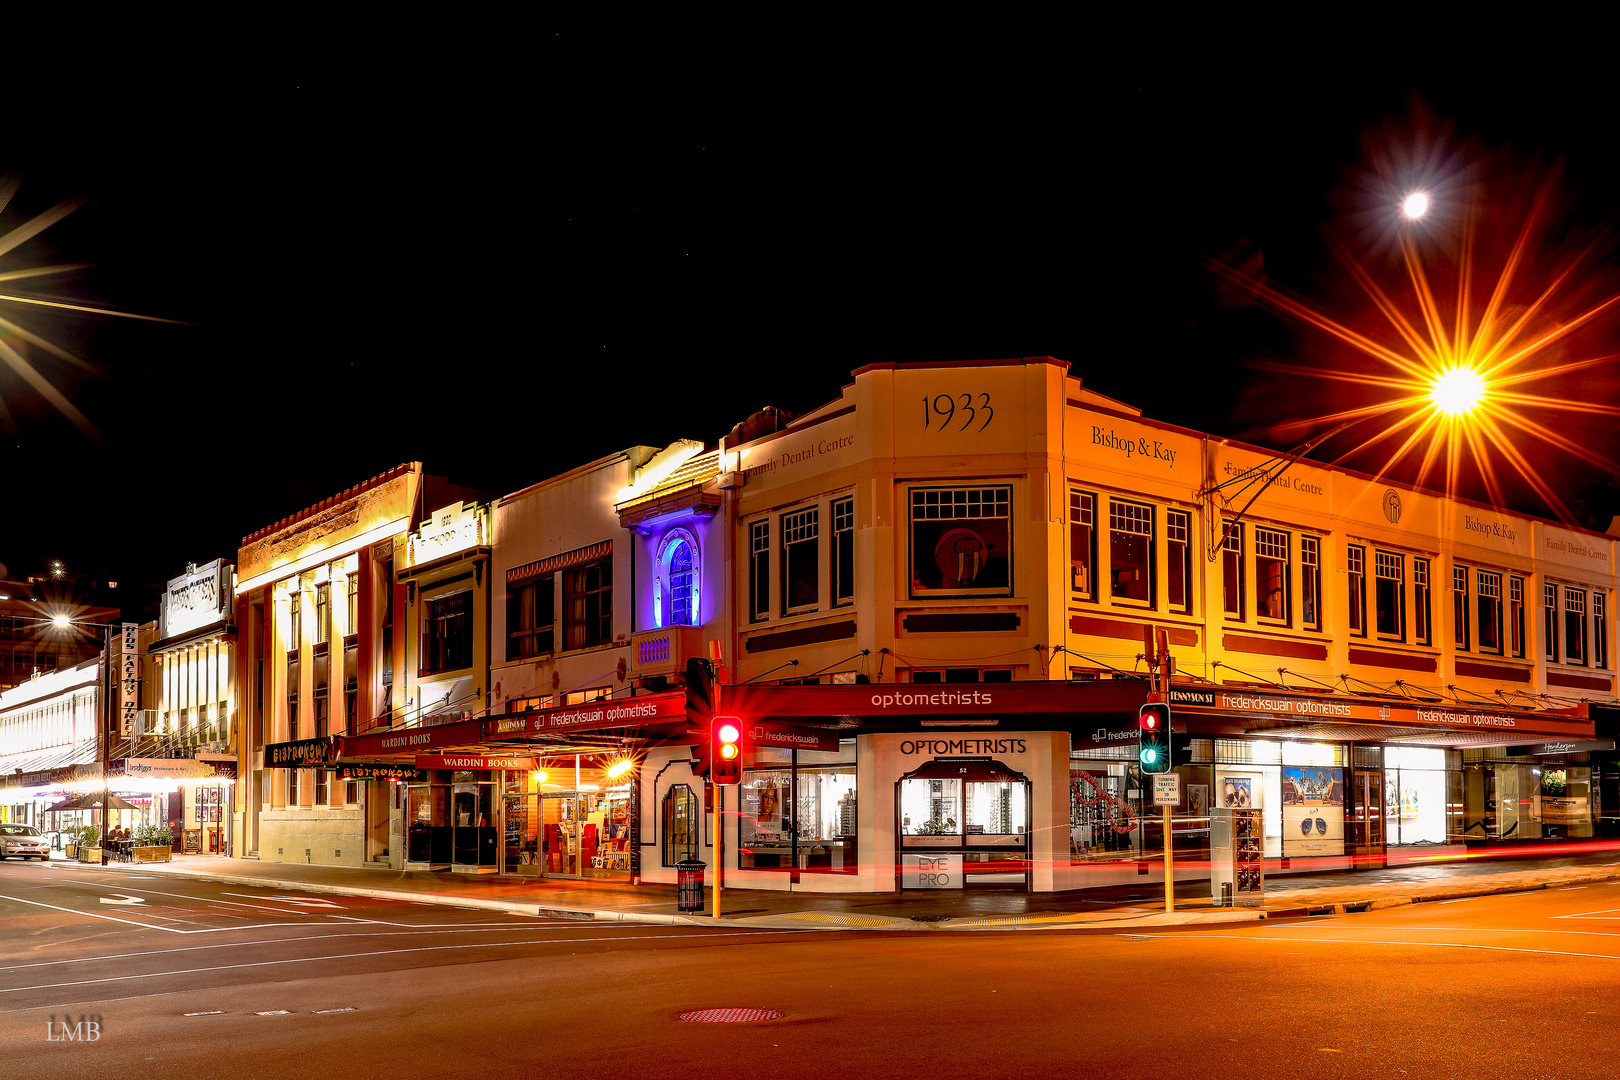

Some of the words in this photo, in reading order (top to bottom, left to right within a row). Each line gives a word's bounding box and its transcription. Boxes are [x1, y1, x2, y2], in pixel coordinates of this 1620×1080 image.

[923, 393, 993, 433] 1933
[1091, 425, 1135, 458] Bishop
[1138, 437, 1151, 457] &
[1153, 441, 1177, 468] Kay
[747, 457, 778, 478] Family
[781, 444, 815, 467] Dental
[817, 435, 854, 455] Centre
[1226, 461, 1257, 484] Family
[1293, 478, 1323, 496] Centre
[1464, 515, 1492, 538] Bishop
[1492, 522, 1501, 536] &
[1501, 524, 1517, 544] Kay
[1546, 538, 1567, 555] Family
[1568, 542, 1587, 557] Dental
[1589, 547, 1608, 561] Centre
[871, 690, 992, 708] optometrists
[1170, 691, 1204, 702] TENNYSON
[1205, 694, 1214, 703] ST
[1221, 693, 1293, 712] frederickswain
[1296, 699, 1351, 716] optometrists
[550, 709, 604, 727] frederickswain
[606, 703, 657, 721] optometrists
[1417, 708, 1470, 724] frederickswain
[1472, 714, 1516, 726] optometrists
[382, 737, 408, 748] WARDINI
[410, 734, 431, 745] BOOKS
[765, 732, 819, 744] frederickswain
[1108, 730, 1140, 740] frederick
[273, 741, 329, 763] BISTRONOMY
[900, 739, 1026, 755] OPTOMETRISTS
[1543, 742, 1576, 753] Henderson
[443, 758, 484, 767] WARDINI
[487, 758, 518, 768] BOOKS
[343, 767, 420, 778] BISTRONOMY
[919, 858, 948, 870] EYE
[919, 873, 949, 886] PRO
